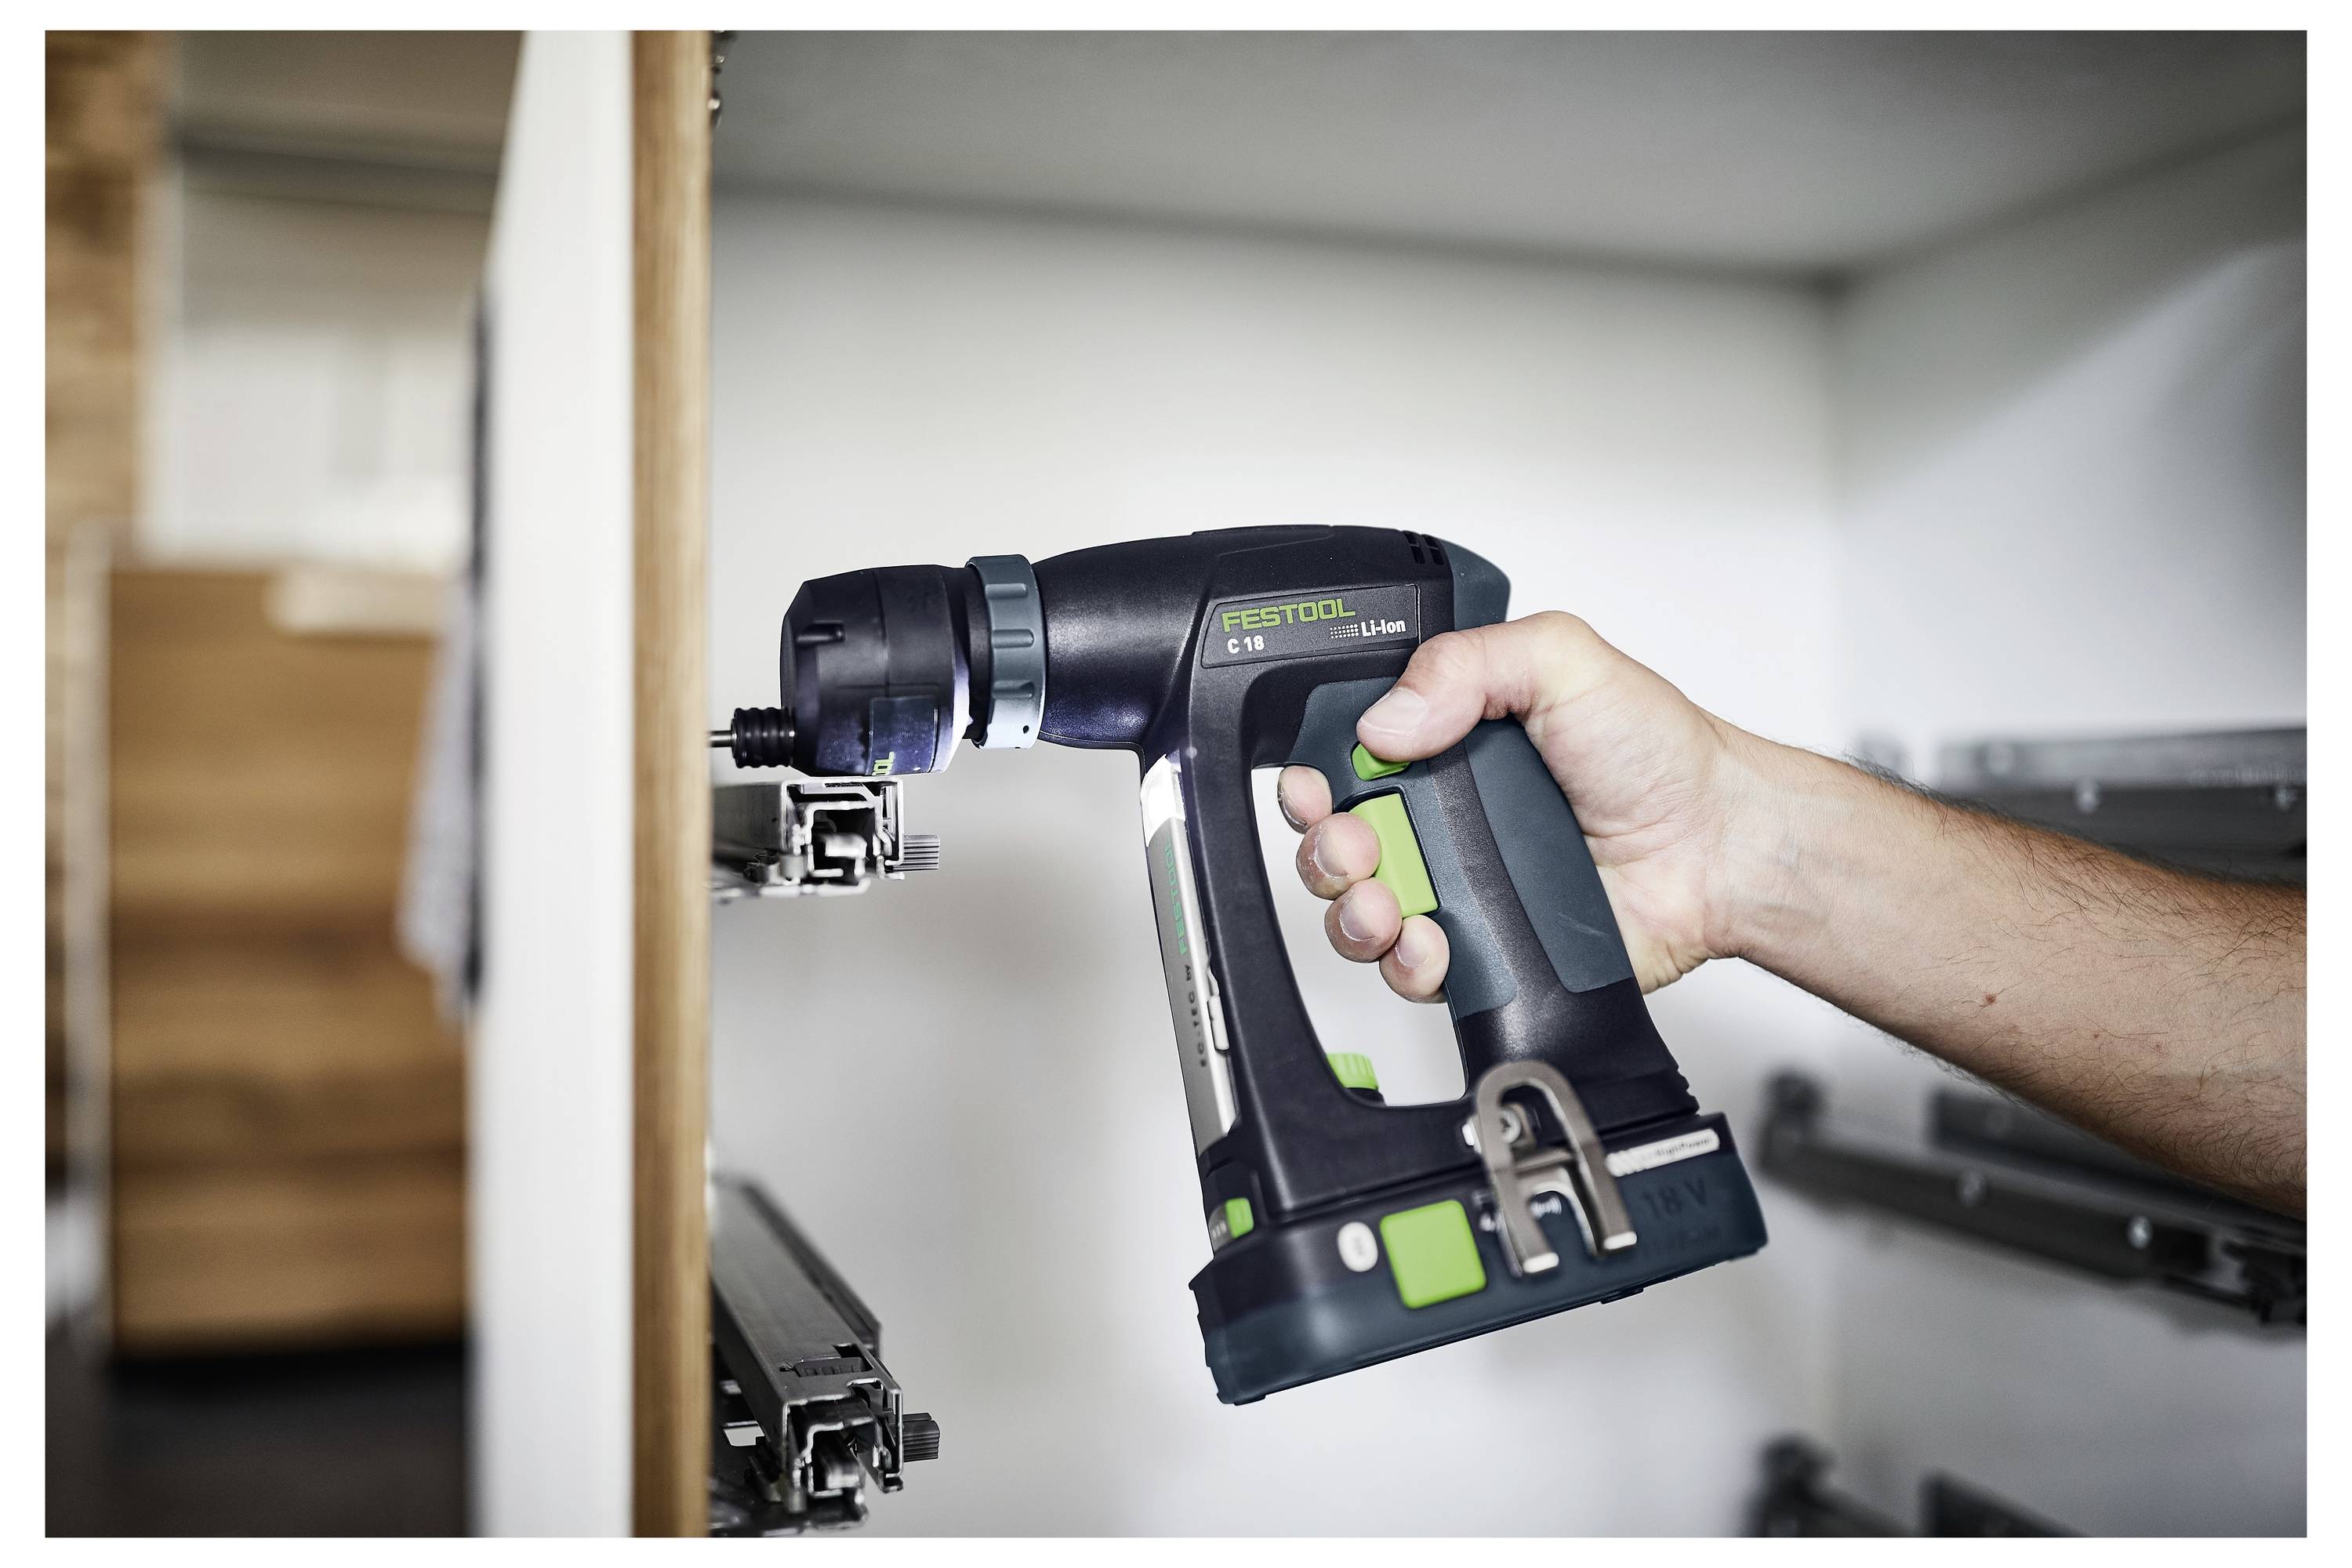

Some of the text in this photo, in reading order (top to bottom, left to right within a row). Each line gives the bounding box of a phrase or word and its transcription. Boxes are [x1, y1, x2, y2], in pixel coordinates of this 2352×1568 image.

[1221, 598, 1356, 633] FESTOOL
[1360, 619, 1406, 637] Li-Ion
[1227, 635, 1265, 654] C 18
[1165, 832, 1188, 955] FESTOOL
[1185, 963, 1192, 982] by
[1643, 1176, 1707, 1221] 18 V
